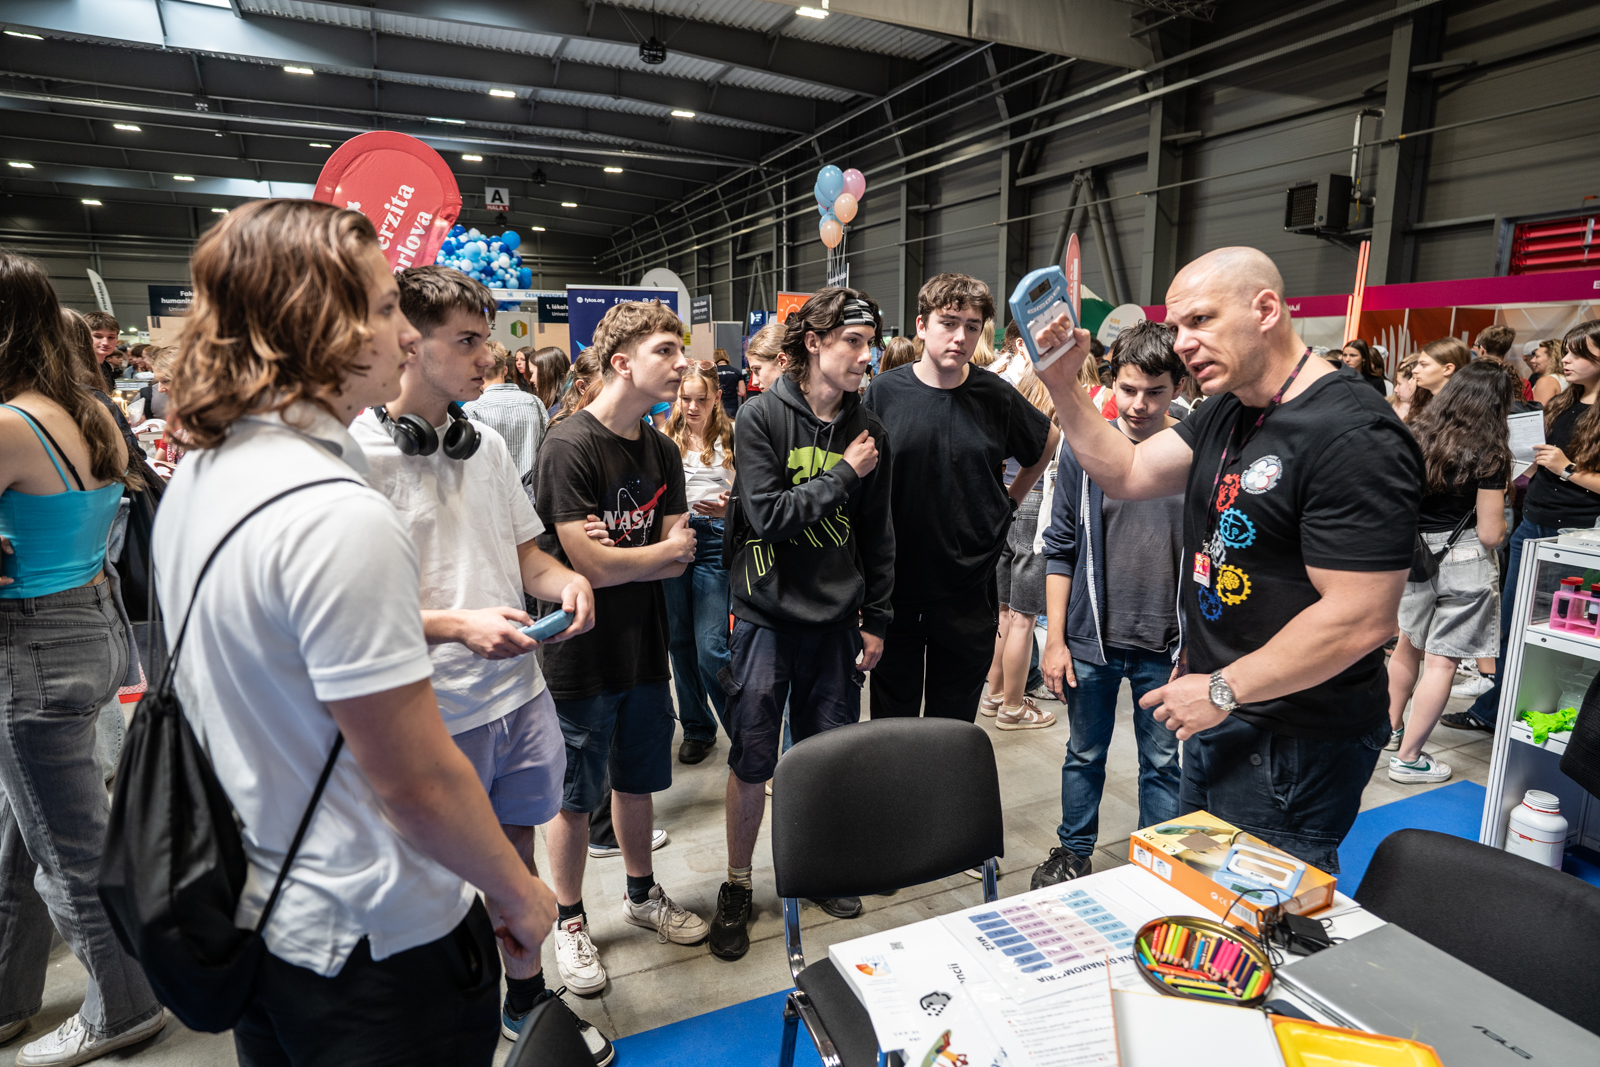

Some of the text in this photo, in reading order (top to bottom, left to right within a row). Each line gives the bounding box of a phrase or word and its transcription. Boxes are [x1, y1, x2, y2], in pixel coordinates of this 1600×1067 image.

[491, 189, 504, 204] A
[378, 184, 415, 251] erzita
[393, 211, 433, 275] arlova
[1110, 317, 1121, 325] KDE
[602, 509, 655, 531] NASA
[976, 936, 995, 951] MUŽ
